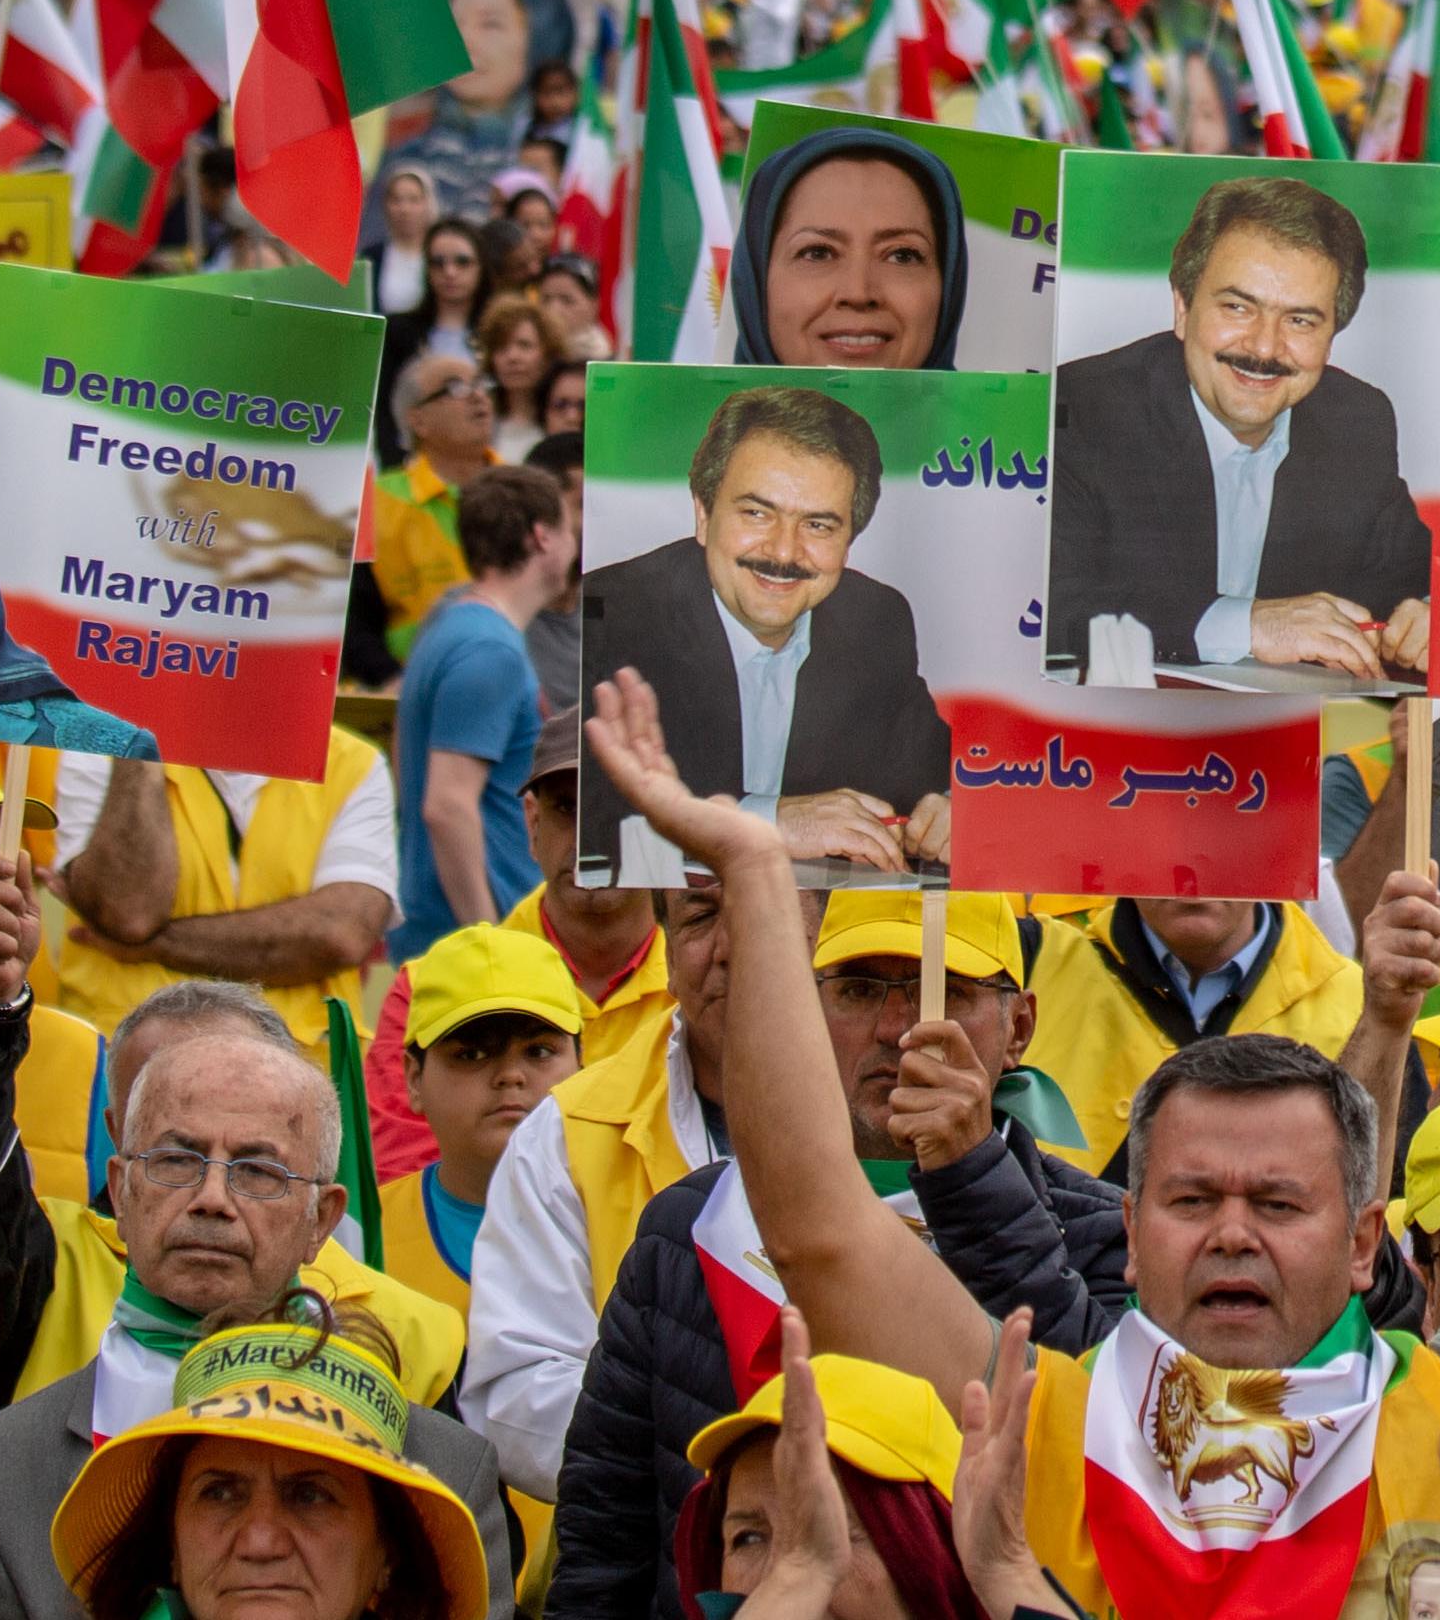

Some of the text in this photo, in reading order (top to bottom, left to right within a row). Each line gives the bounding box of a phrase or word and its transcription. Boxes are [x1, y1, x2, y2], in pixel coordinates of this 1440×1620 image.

[40, 356, 343, 446] Democracy
[67, 423, 298, 493] Freedom
[135, 509, 219, 550] with
[60, 554, 271, 621] Maryam
[76, 620, 241, 680] Rajavi
[954, 733, 1267, 812] رهبر ماست
